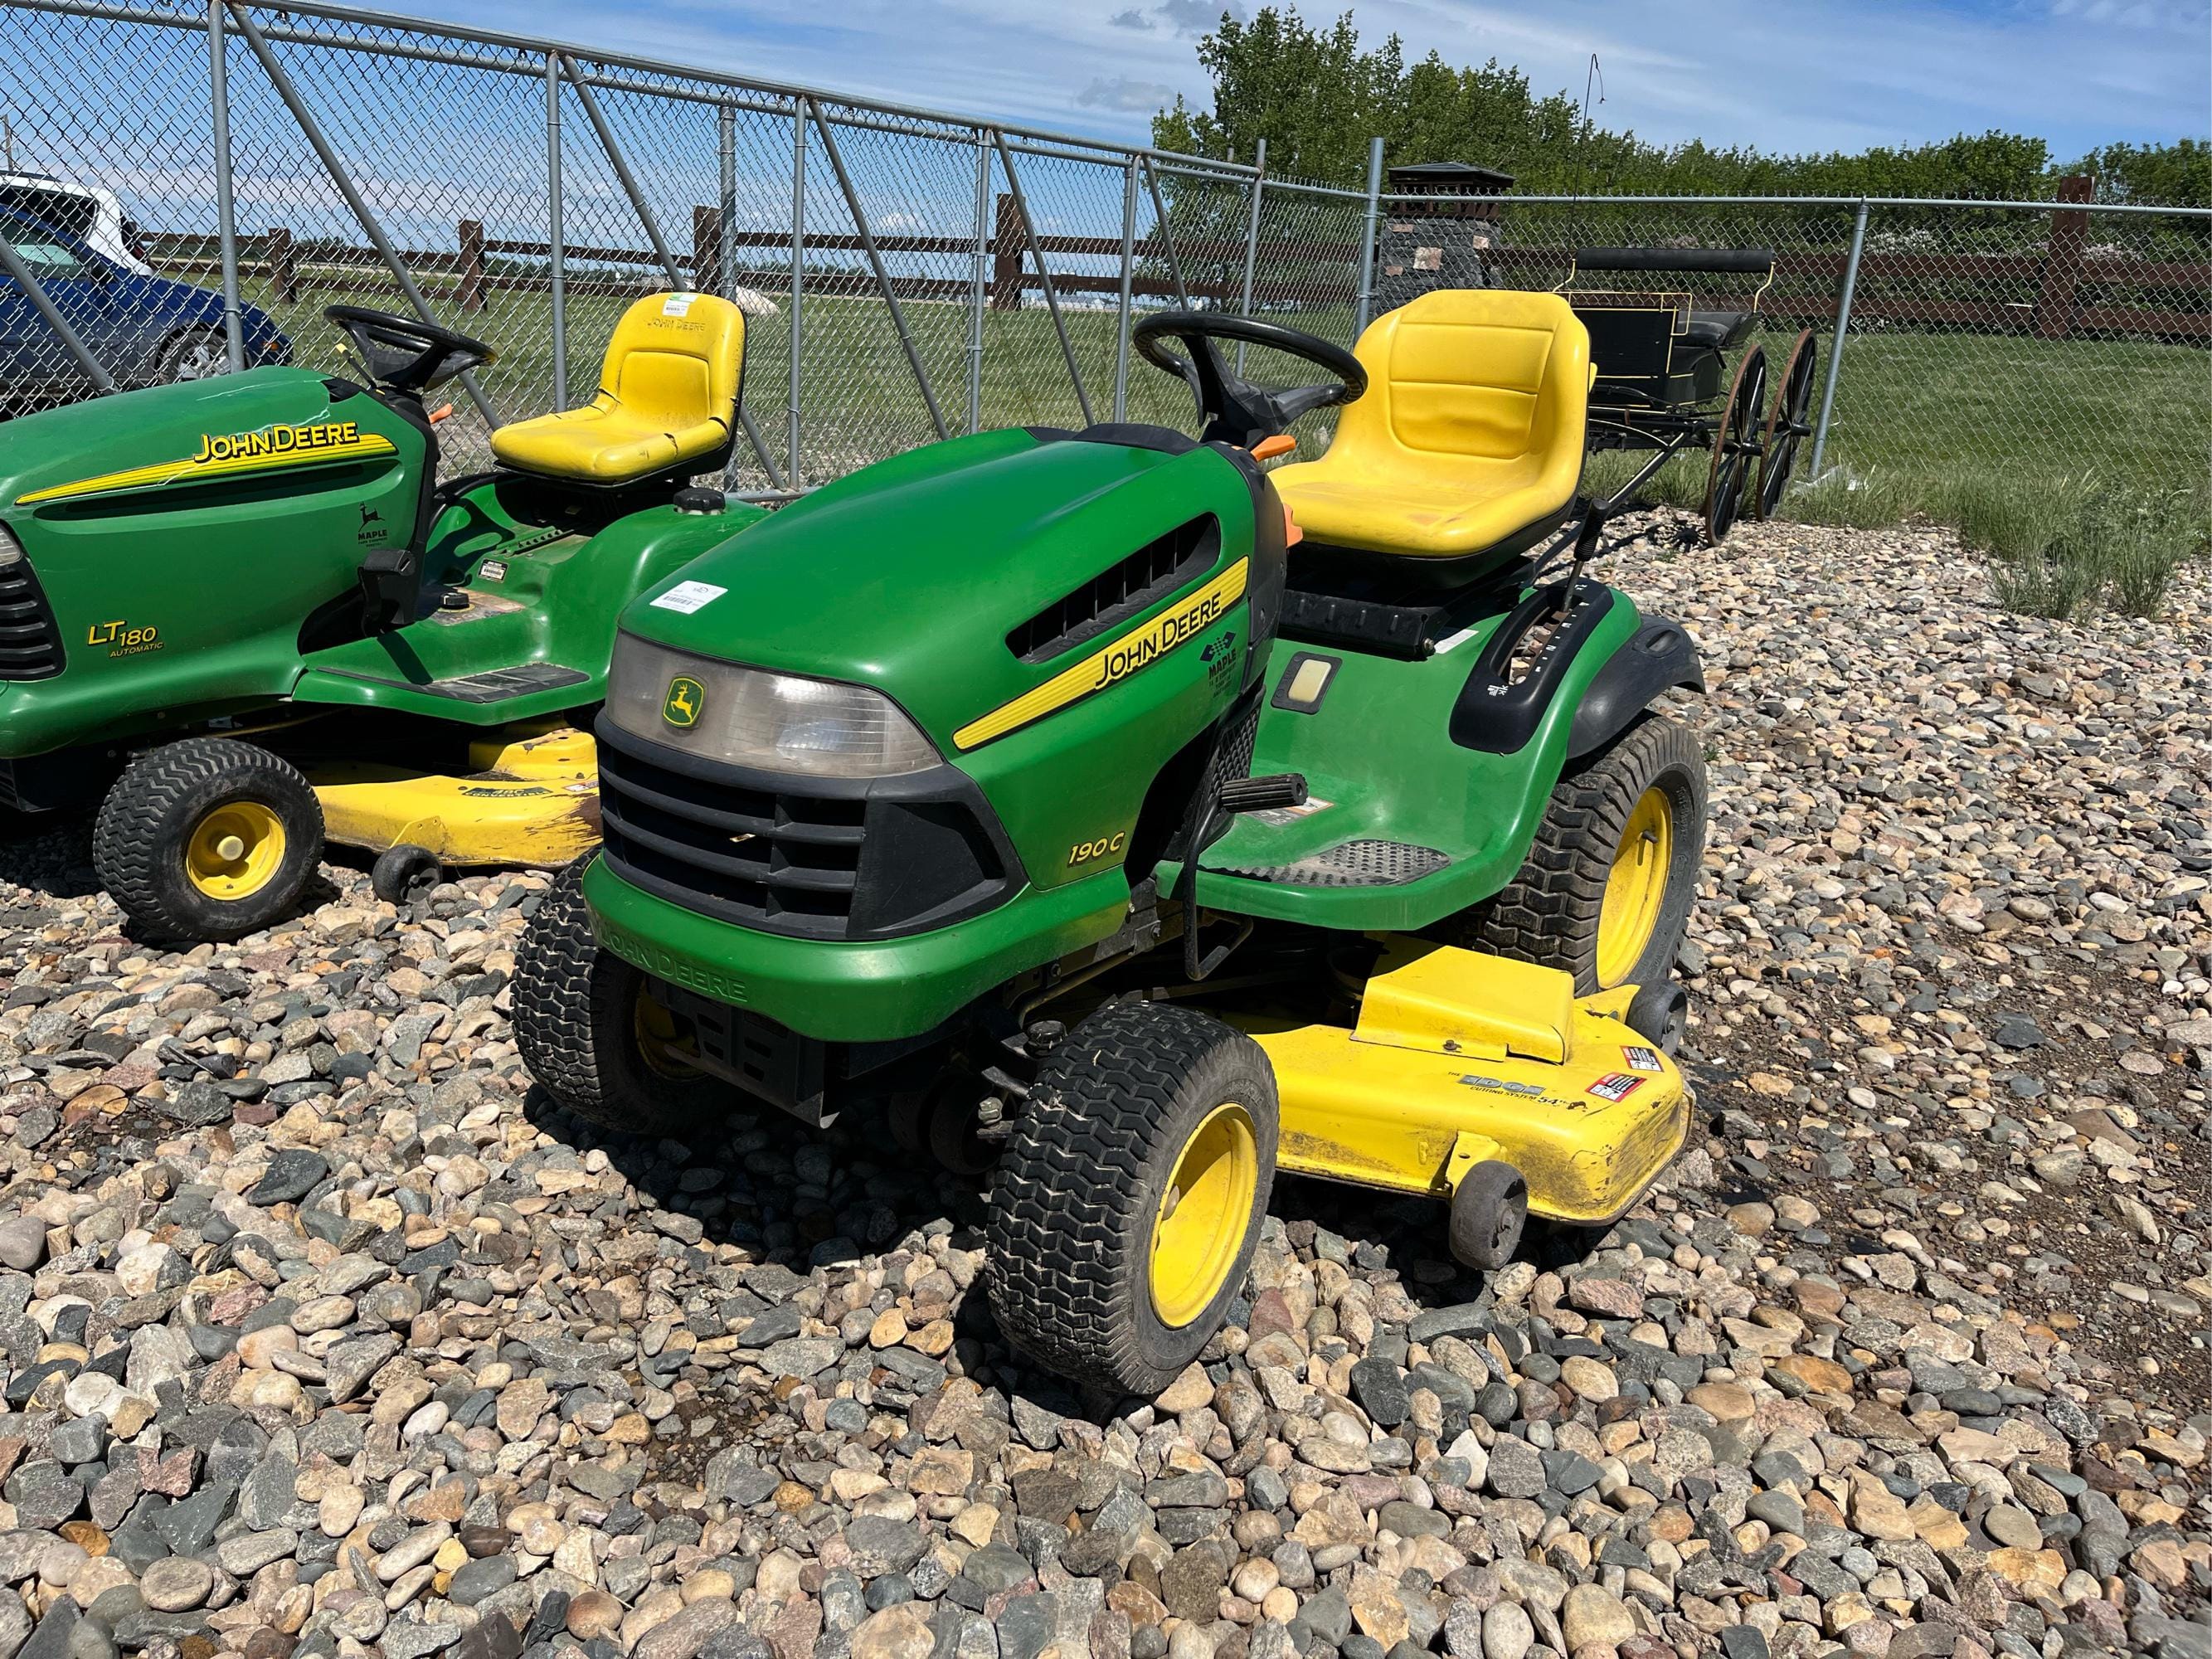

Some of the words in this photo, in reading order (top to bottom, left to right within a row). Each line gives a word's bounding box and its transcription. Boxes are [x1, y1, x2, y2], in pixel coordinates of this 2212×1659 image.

[193, 434, 273, 464] JOHN
[272, 421, 360, 452] DEERE
[358, 529, 388, 540] MAPLE
[87, 620, 127, 645] LT
[119, 626, 158, 647] 180
[1095, 633, 1157, 689] JOHN
[1162, 591, 1222, 651] DEERE
[109, 642, 164, 658] AUTOMATIC
[1208, 648, 1237, 680] MAPLE
[599, 922, 652, 969] JOHN
[656, 948, 748, 1002] DEERE
[1456, 1074, 1546, 1096] EDGE
[1470, 1086, 1504, 1095] CUTTING
[1505, 1091, 1537, 1101] SYSTEM
